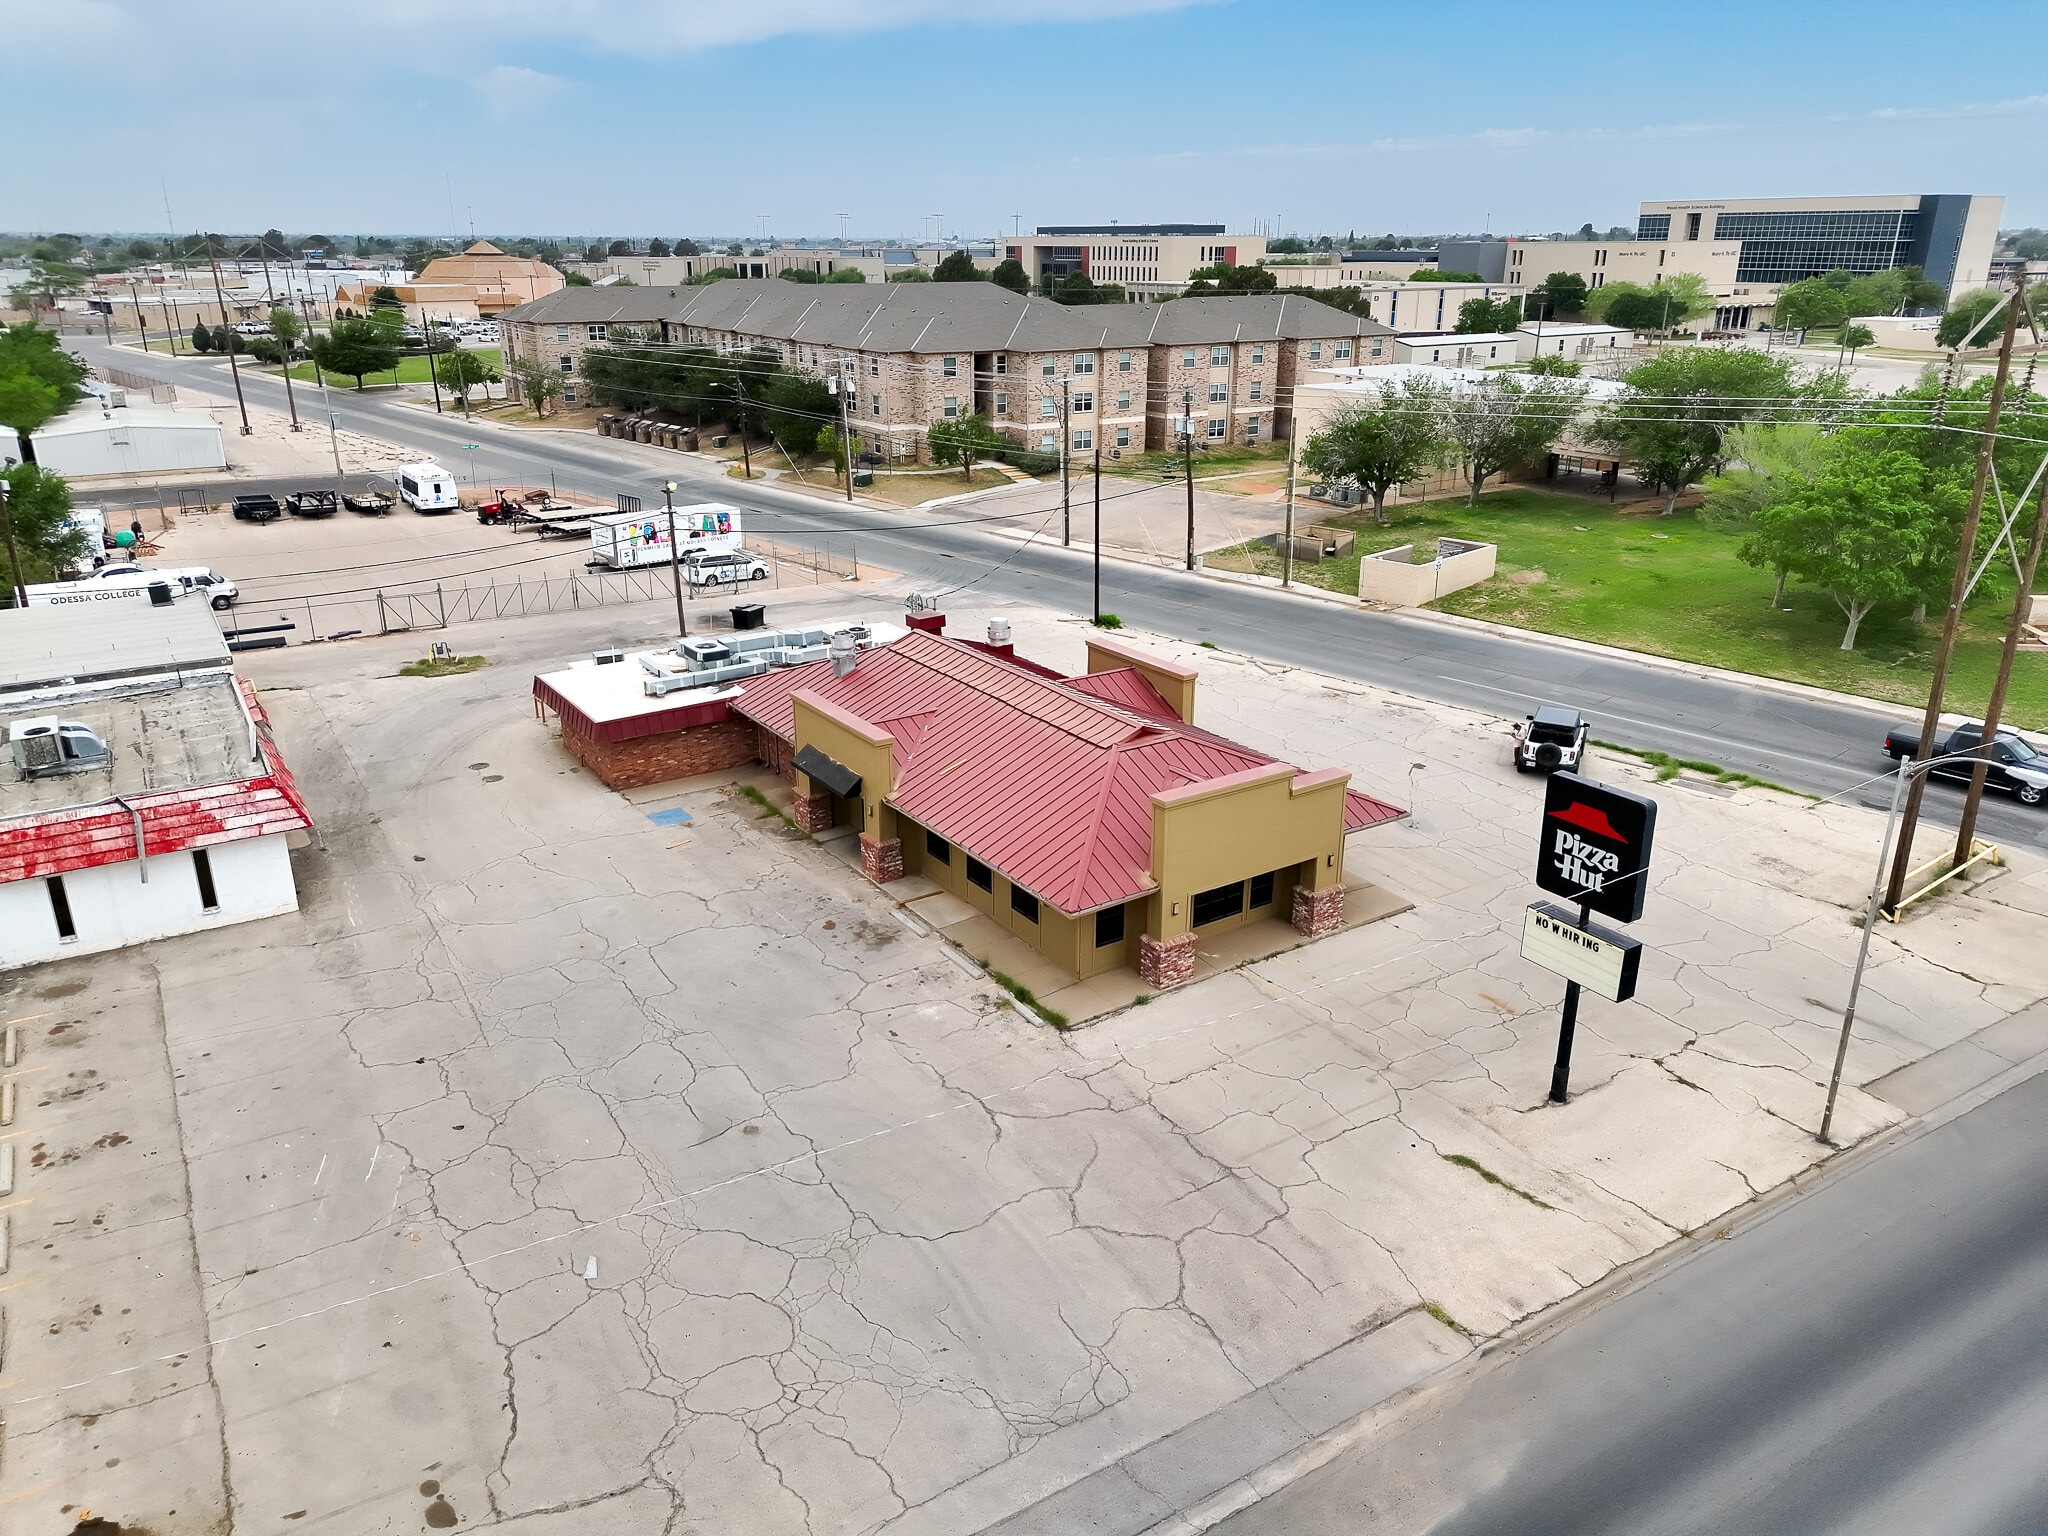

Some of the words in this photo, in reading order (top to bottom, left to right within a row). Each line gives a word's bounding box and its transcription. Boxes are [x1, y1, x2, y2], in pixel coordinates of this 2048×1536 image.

[50, 594, 92, 605] ODESSA
[94, 589, 141, 601] COLLEGE
[1554, 828, 1619, 872] Pizza
[1554, 853, 1605, 893] Hut
